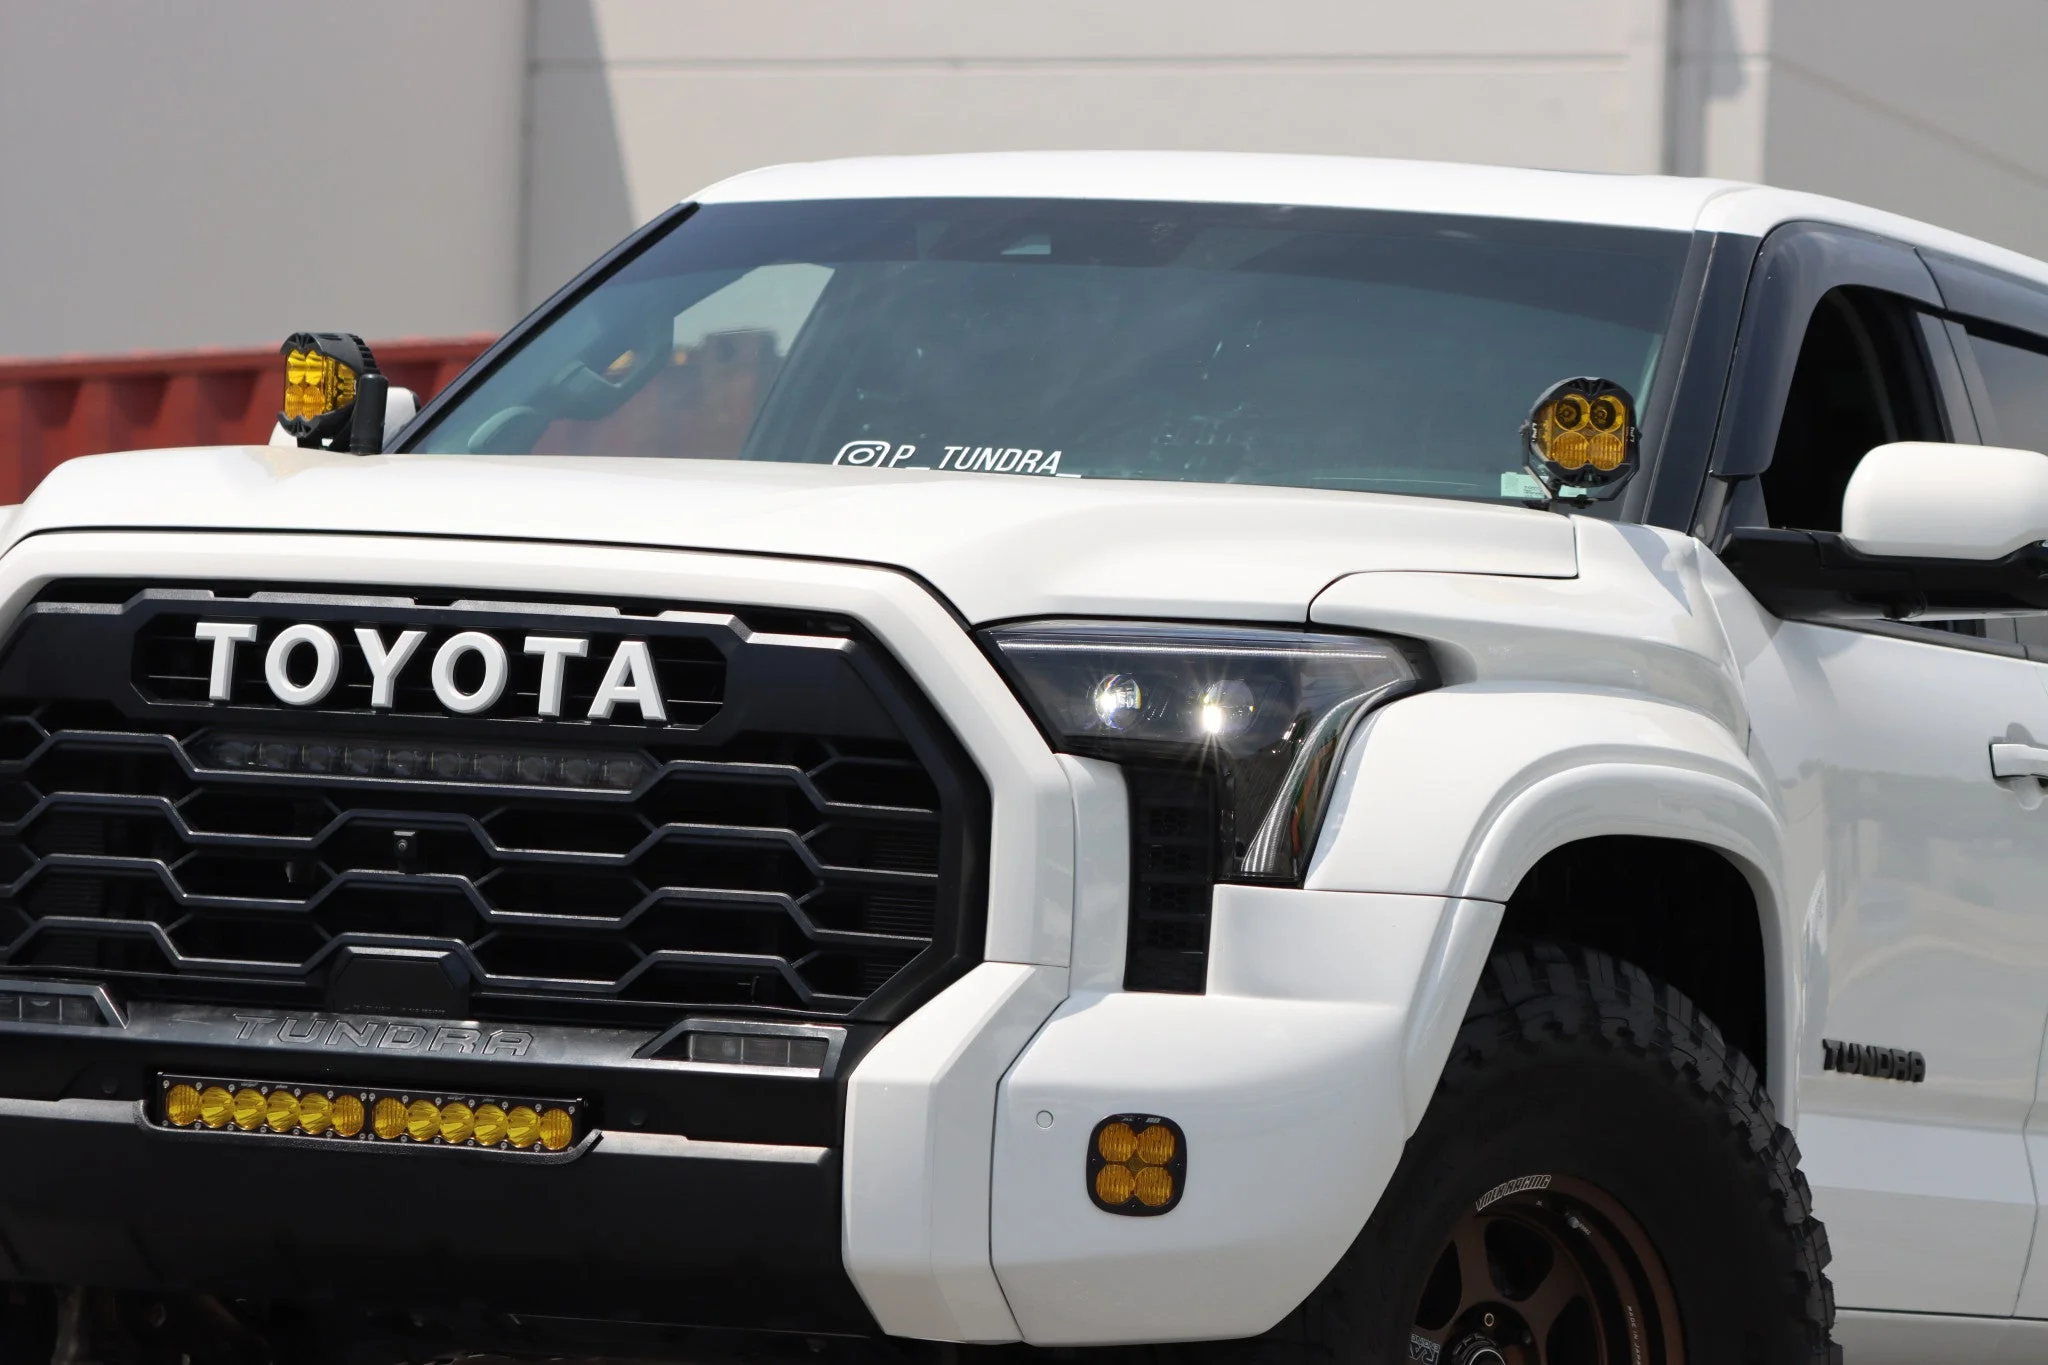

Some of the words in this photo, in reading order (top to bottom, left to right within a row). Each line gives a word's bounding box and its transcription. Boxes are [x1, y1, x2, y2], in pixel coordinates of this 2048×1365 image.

[195, 622, 667, 722] TOYOTA
[233, 1013, 535, 1057] TUNDRA
[1822, 1038, 1926, 1082] TUNDRA
[1503, 1174, 1552, 1197] RACING
[1626, 1305, 1637, 1329] MADE
